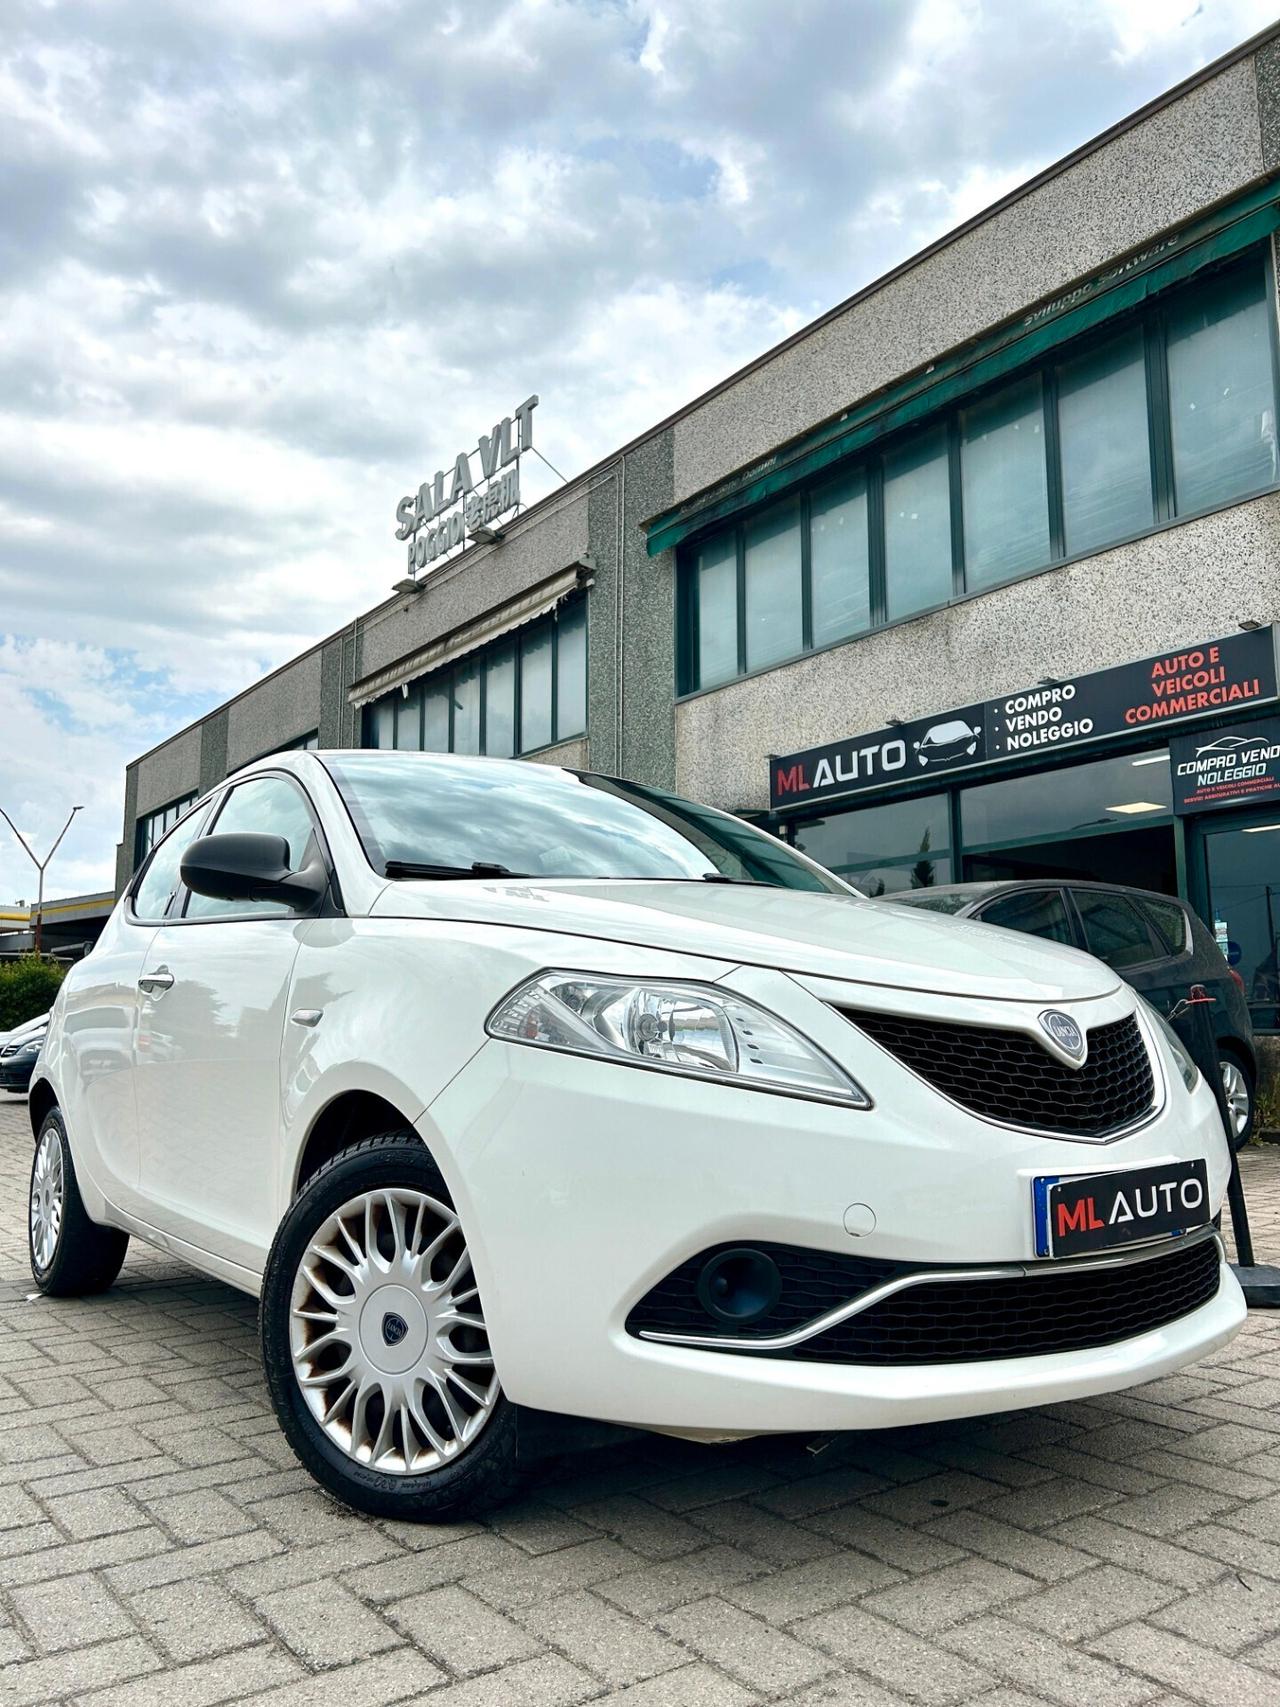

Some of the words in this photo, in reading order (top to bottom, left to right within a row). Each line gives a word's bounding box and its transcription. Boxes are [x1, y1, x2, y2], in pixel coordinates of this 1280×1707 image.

[395, 452, 473, 541] SALA
[478, 394, 539, 480] VLT
[408, 511, 465, 574] POGGIO
[1151, 650, 1204, 679] AUTO
[1210, 646, 1220, 663] E
[1152, 666, 1226, 697] VEICOLI
[1004, 684, 1076, 715] COMPRO
[1124, 678, 1260, 724] COMMERCIALI
[1005, 707, 1062, 732] VENDO
[1006, 718, 1094, 751] NOLEGGIO
[1177, 753, 1236, 776] COMPRO
[1197, 762, 1267, 786] NOLEGGIO
